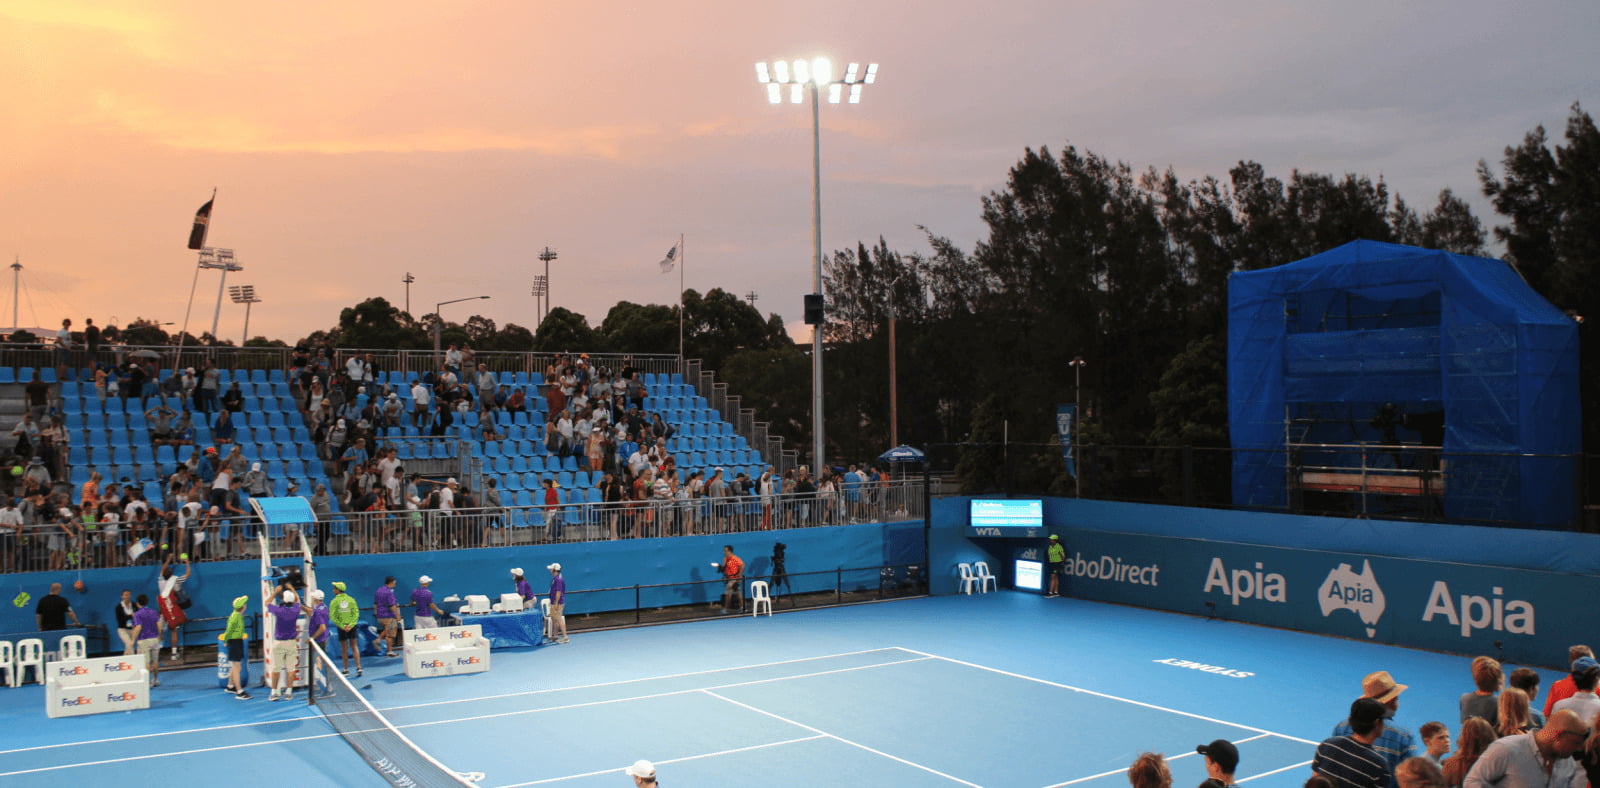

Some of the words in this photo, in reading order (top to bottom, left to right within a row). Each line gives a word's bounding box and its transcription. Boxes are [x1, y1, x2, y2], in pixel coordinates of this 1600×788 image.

[976, 528, 1001, 536] WTA
[1063, 552, 1160, 586] aboDirect
[1203, 557, 1287, 605] Apia
[1328, 581, 1373, 604] Apia
[1422, 581, 1536, 637] Apia
[414, 633, 437, 642] FedEx
[450, 631, 472, 639] FedEx
[421, 660, 444, 668] FedEx
[457, 656, 480, 665] FedEx
[59, 666, 89, 676] FedEx
[104, 662, 132, 672] FedEx
[1152, 658, 1256, 678] SYDNEY
[62, 696, 92, 707] FedEx
[107, 692, 136, 702] FedEx
